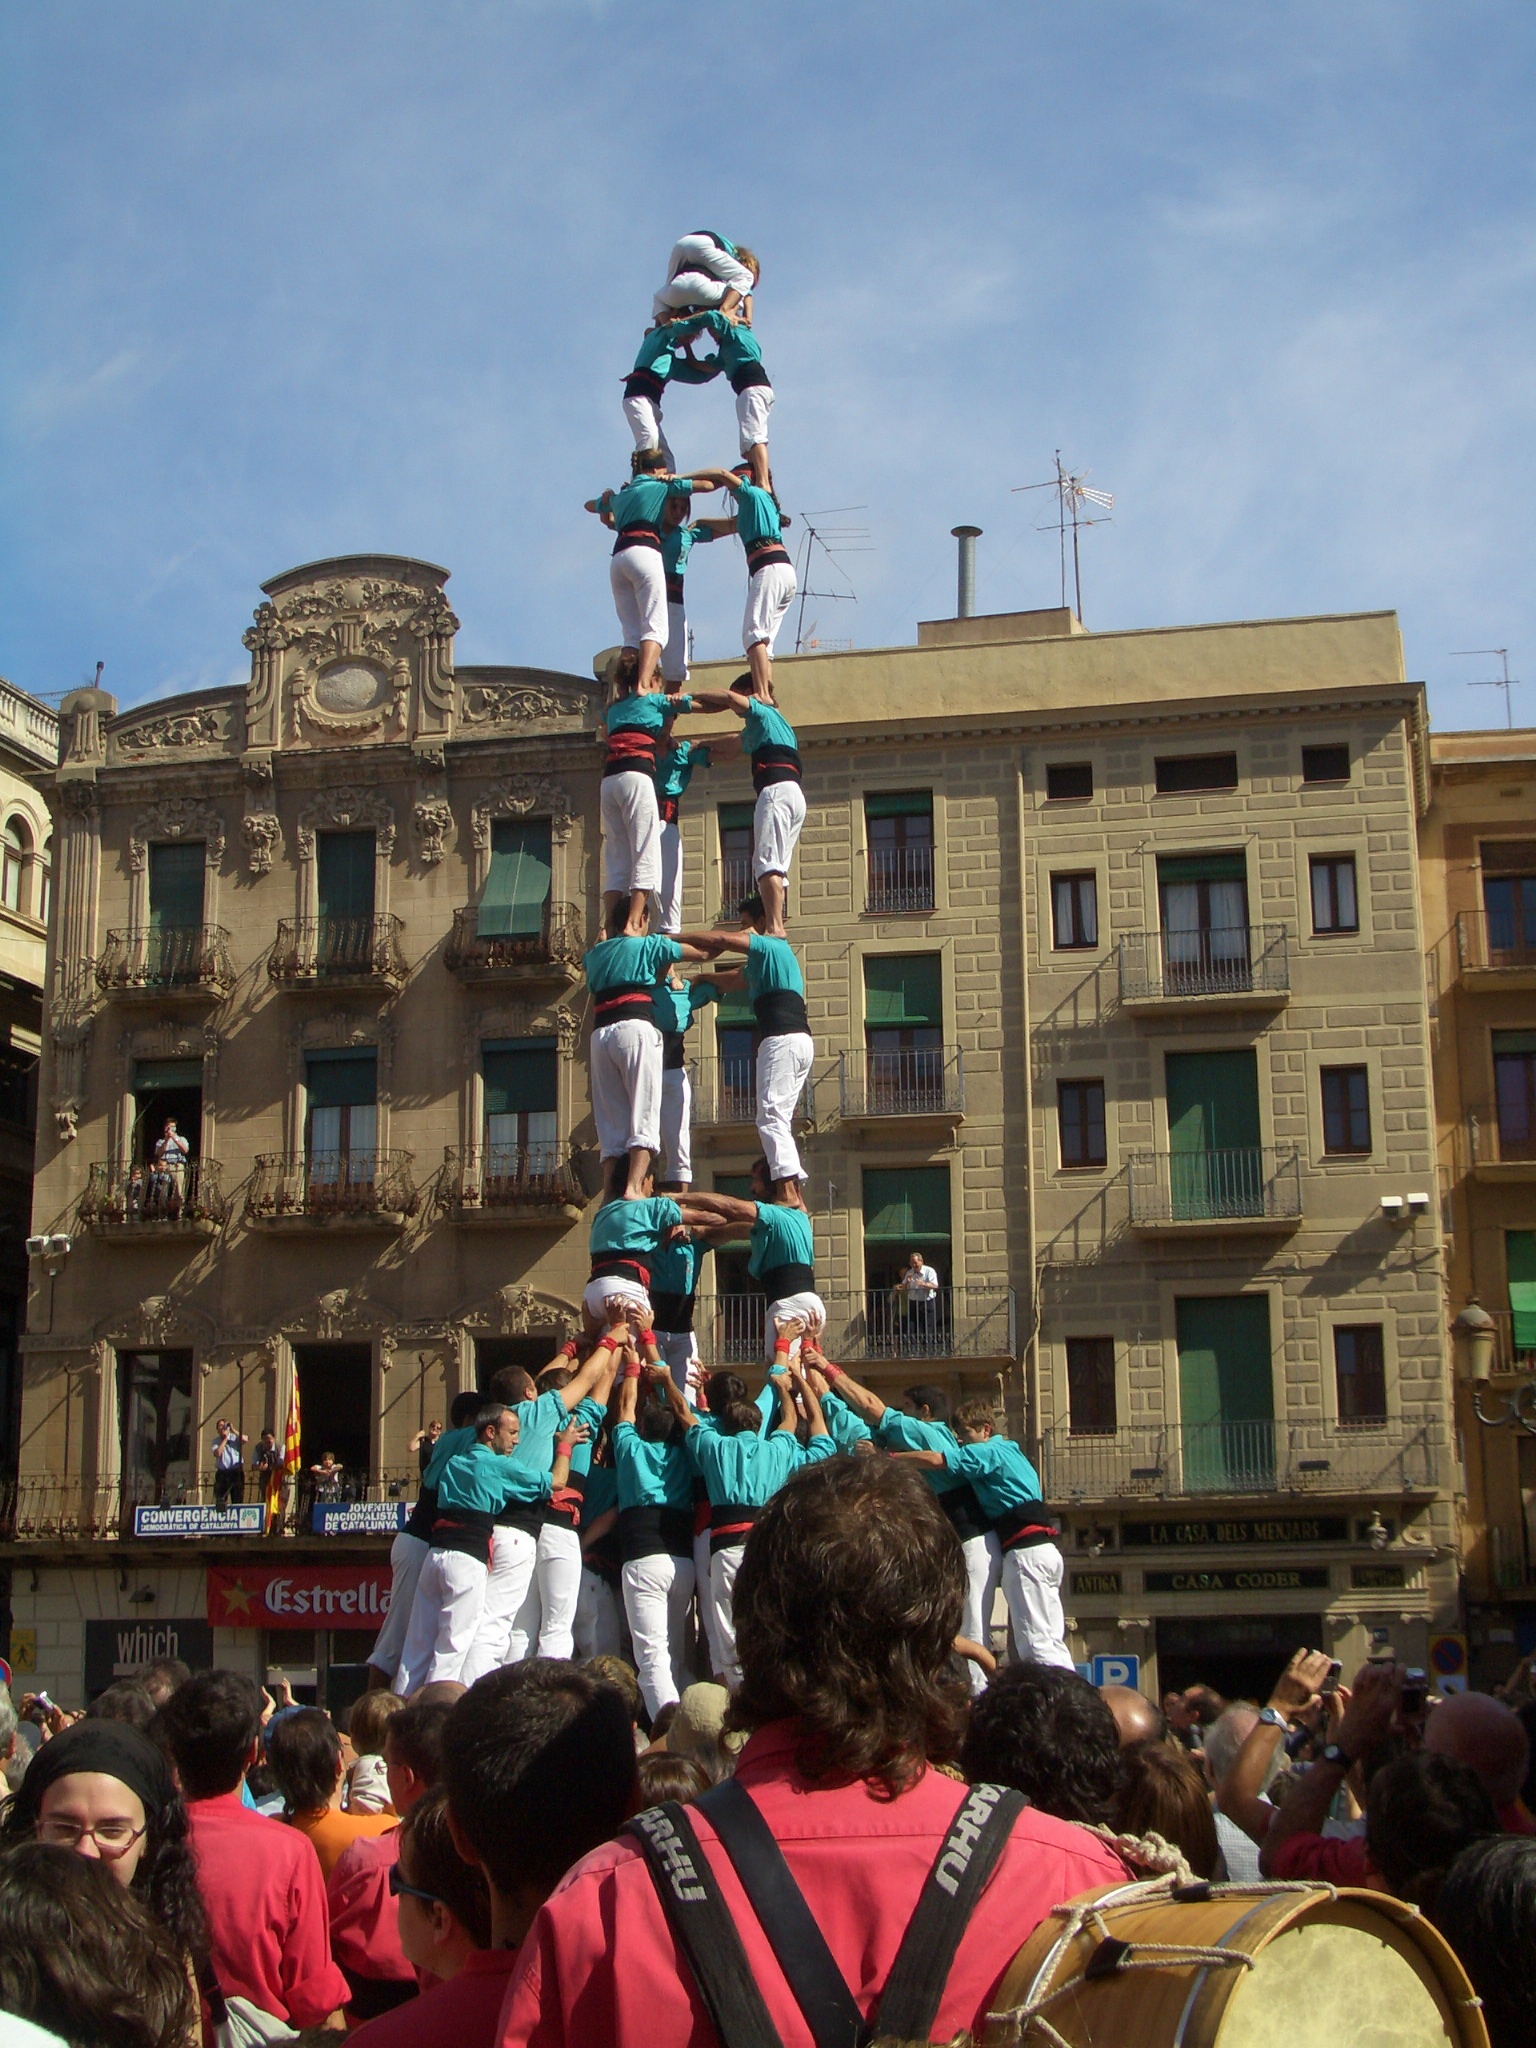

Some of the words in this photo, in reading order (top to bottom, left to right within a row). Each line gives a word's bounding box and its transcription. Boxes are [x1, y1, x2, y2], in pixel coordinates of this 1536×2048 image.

[325, 1512, 398, 1521] NACIONALISTA
[349, 1503, 399, 1512] JOVENTUT
[325, 1521, 339, 1531] DE
[341, 1520, 399, 1530] CATALUNYA
[1150, 1526, 1169, 1543] LA
[1176, 1524, 1209, 1543] CASA
[1216, 1523, 1247, 1542] DELS
[1172, 1574, 1224, 1589] CASA
[1235, 1571, 1301, 1588] CODER
[265, 1577, 391, 1614] Estrella
[118, 1625, 179, 1664] which
[1103, 1661, 1129, 1686] P
[632, 1806, 707, 1901] ARHU
